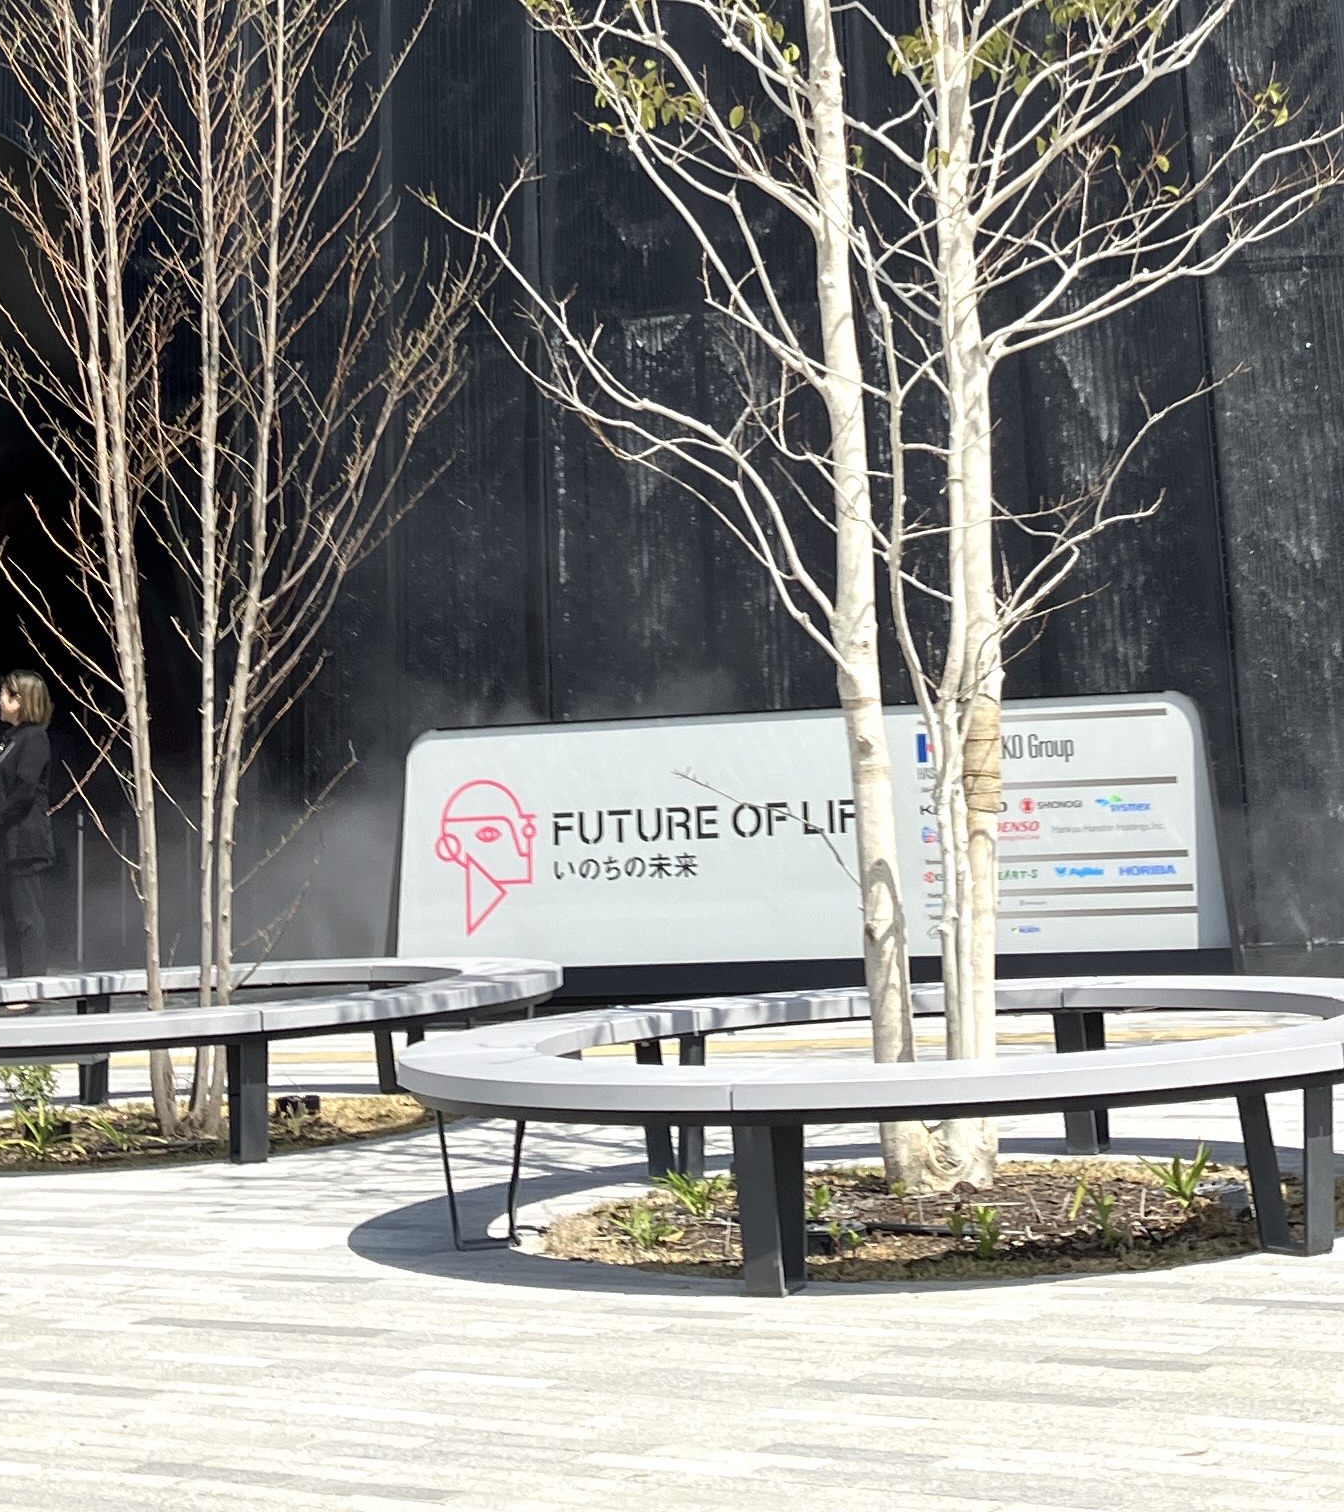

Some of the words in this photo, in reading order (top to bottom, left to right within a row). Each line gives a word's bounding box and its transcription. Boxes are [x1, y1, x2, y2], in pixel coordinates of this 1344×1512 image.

[1001, 734, 1024, 760] KO
[1027, 733, 1075, 763] Group
[552, 804, 720, 846] FUTURE
[732, 801, 788, 838] OF
[802, 799, 856, 835] LIF
[552, 852, 699, 881] いのちの未来
